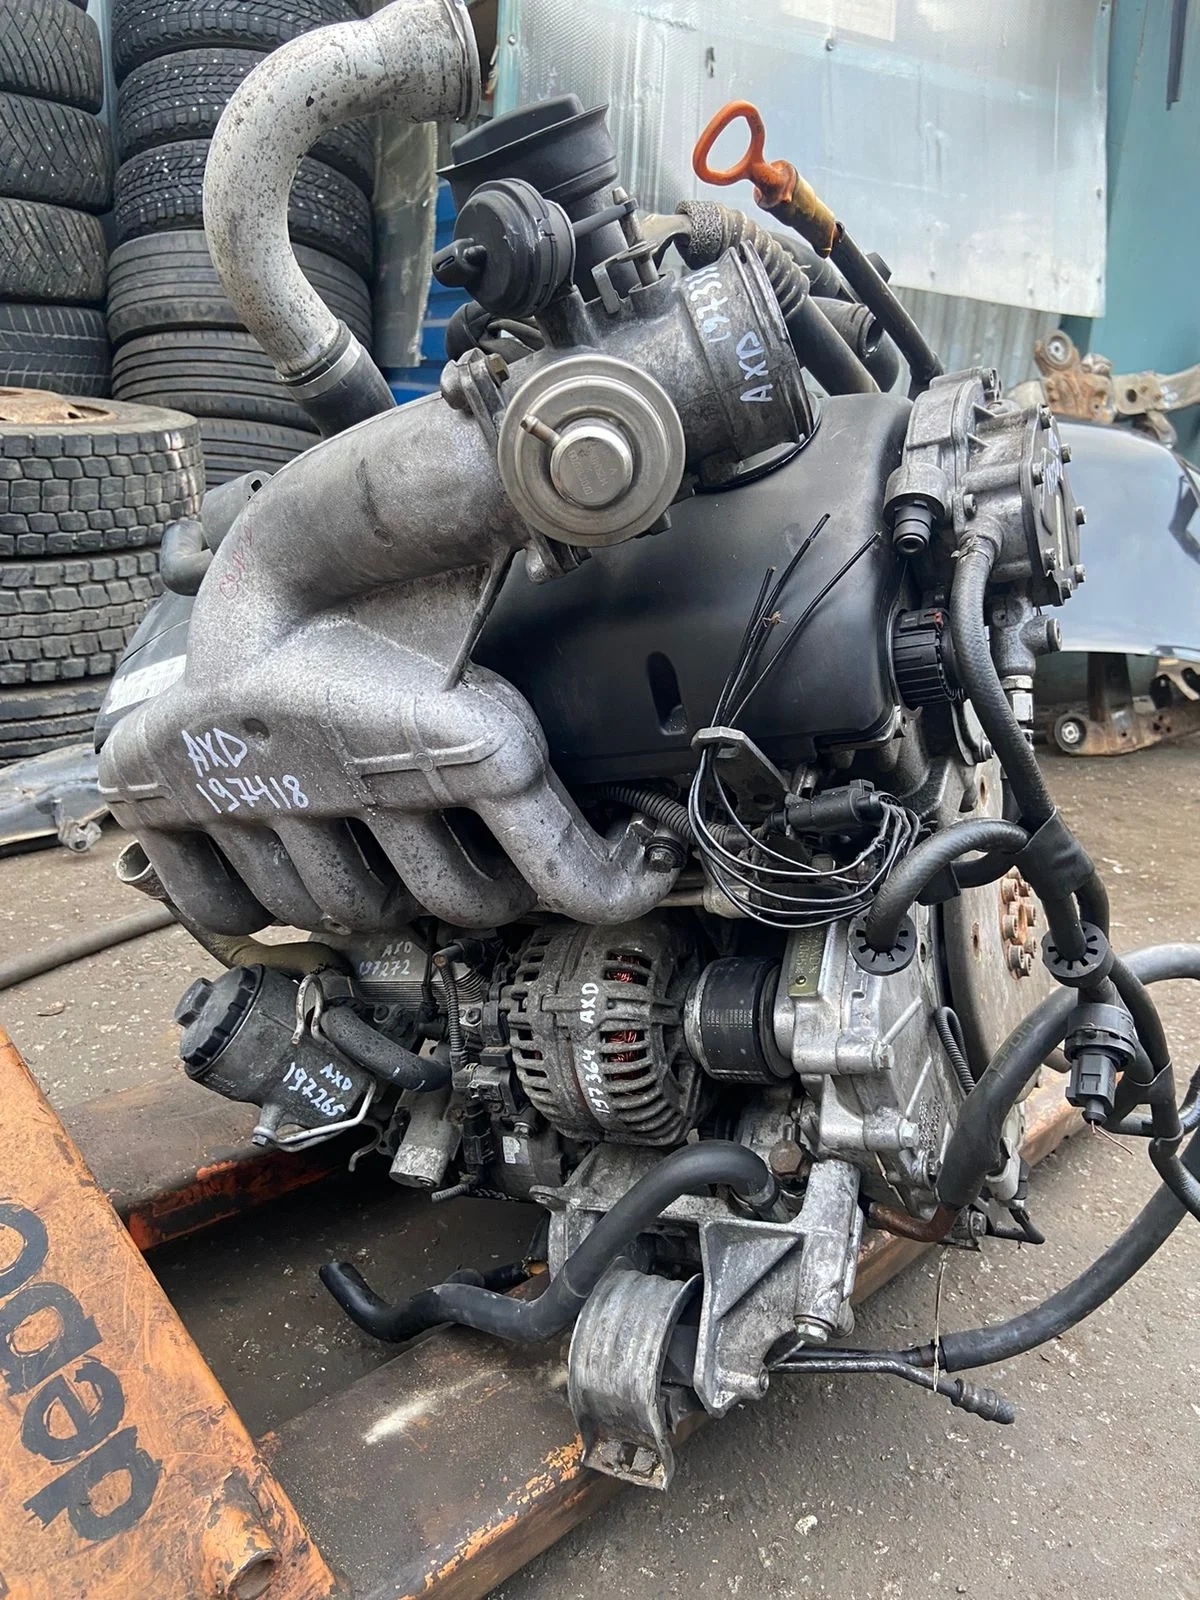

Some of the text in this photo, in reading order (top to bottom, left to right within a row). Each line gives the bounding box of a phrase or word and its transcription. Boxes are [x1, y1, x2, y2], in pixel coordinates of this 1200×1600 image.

[736, 331, 774, 402] AXD
[181, 727, 248, 777] AXD
[196, 774, 309, 814] 197418
[359, 959, 410, 977] 197272
[579, 982, 599, 1024] AXD
[282, 1061, 347, 1116] 197265
[320, 1063, 353, 1091] AXD
